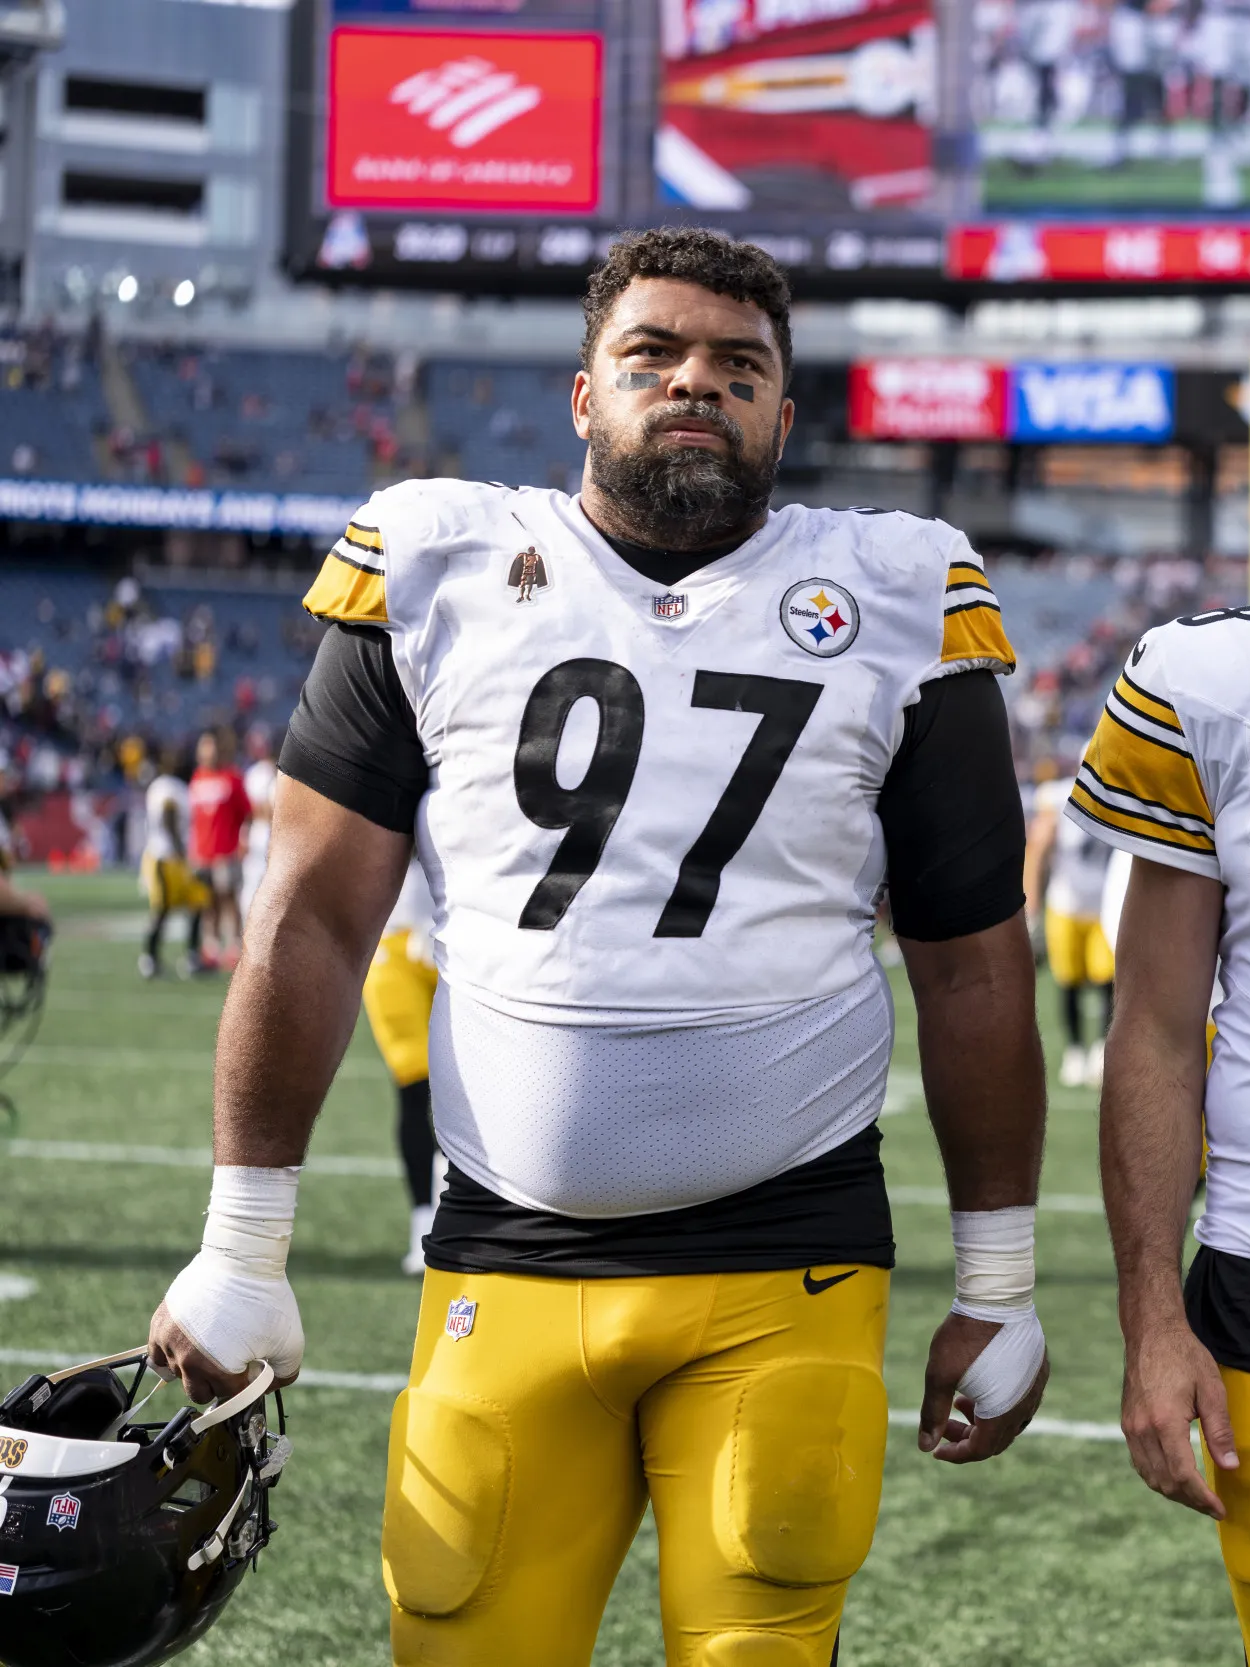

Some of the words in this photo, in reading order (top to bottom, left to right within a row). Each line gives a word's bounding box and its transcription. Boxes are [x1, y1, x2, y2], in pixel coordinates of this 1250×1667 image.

[1022, 367, 1169, 432] VISA
[657, 604, 681, 616] NFL
[790, 606, 820, 620] Steelers
[513, 657, 825, 938] 97
[450, 1316, 467, 1332] NFL
[55, 1498, 77, 1515] NFL
